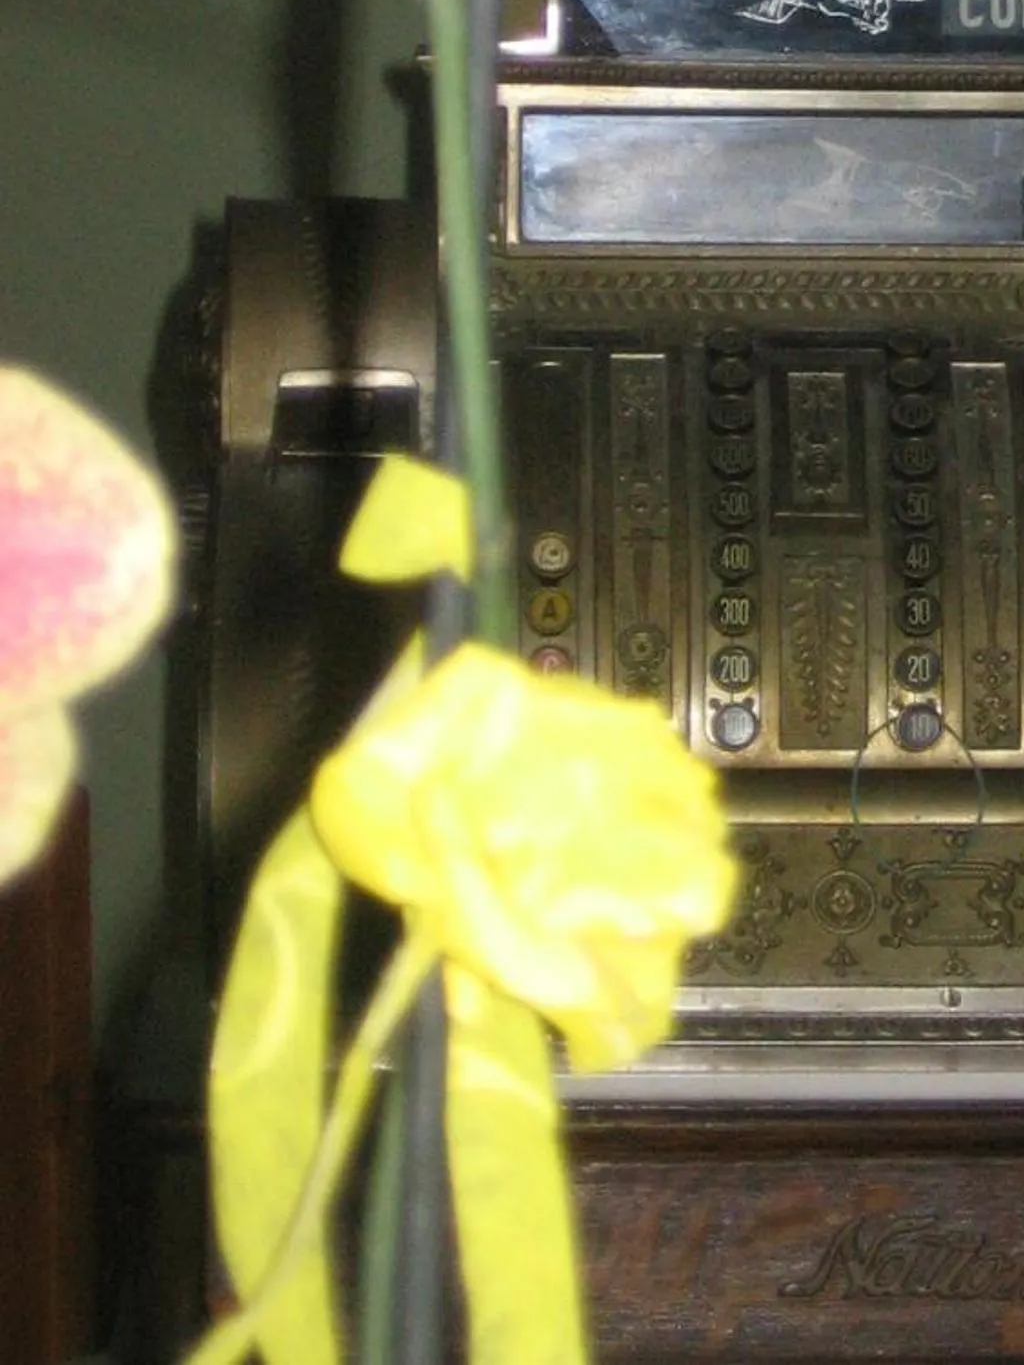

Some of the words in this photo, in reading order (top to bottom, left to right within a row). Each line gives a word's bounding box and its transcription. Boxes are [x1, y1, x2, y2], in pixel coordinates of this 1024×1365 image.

[720, 545, 750, 570] 400
[906, 544, 931, 570] 40
[720, 600, 751, 626] 300
[907, 600, 931, 626] 30
[719, 656, 751, 683] 200
[907, 656, 931, 683] 20
[908, 713, 930, 739] 10
